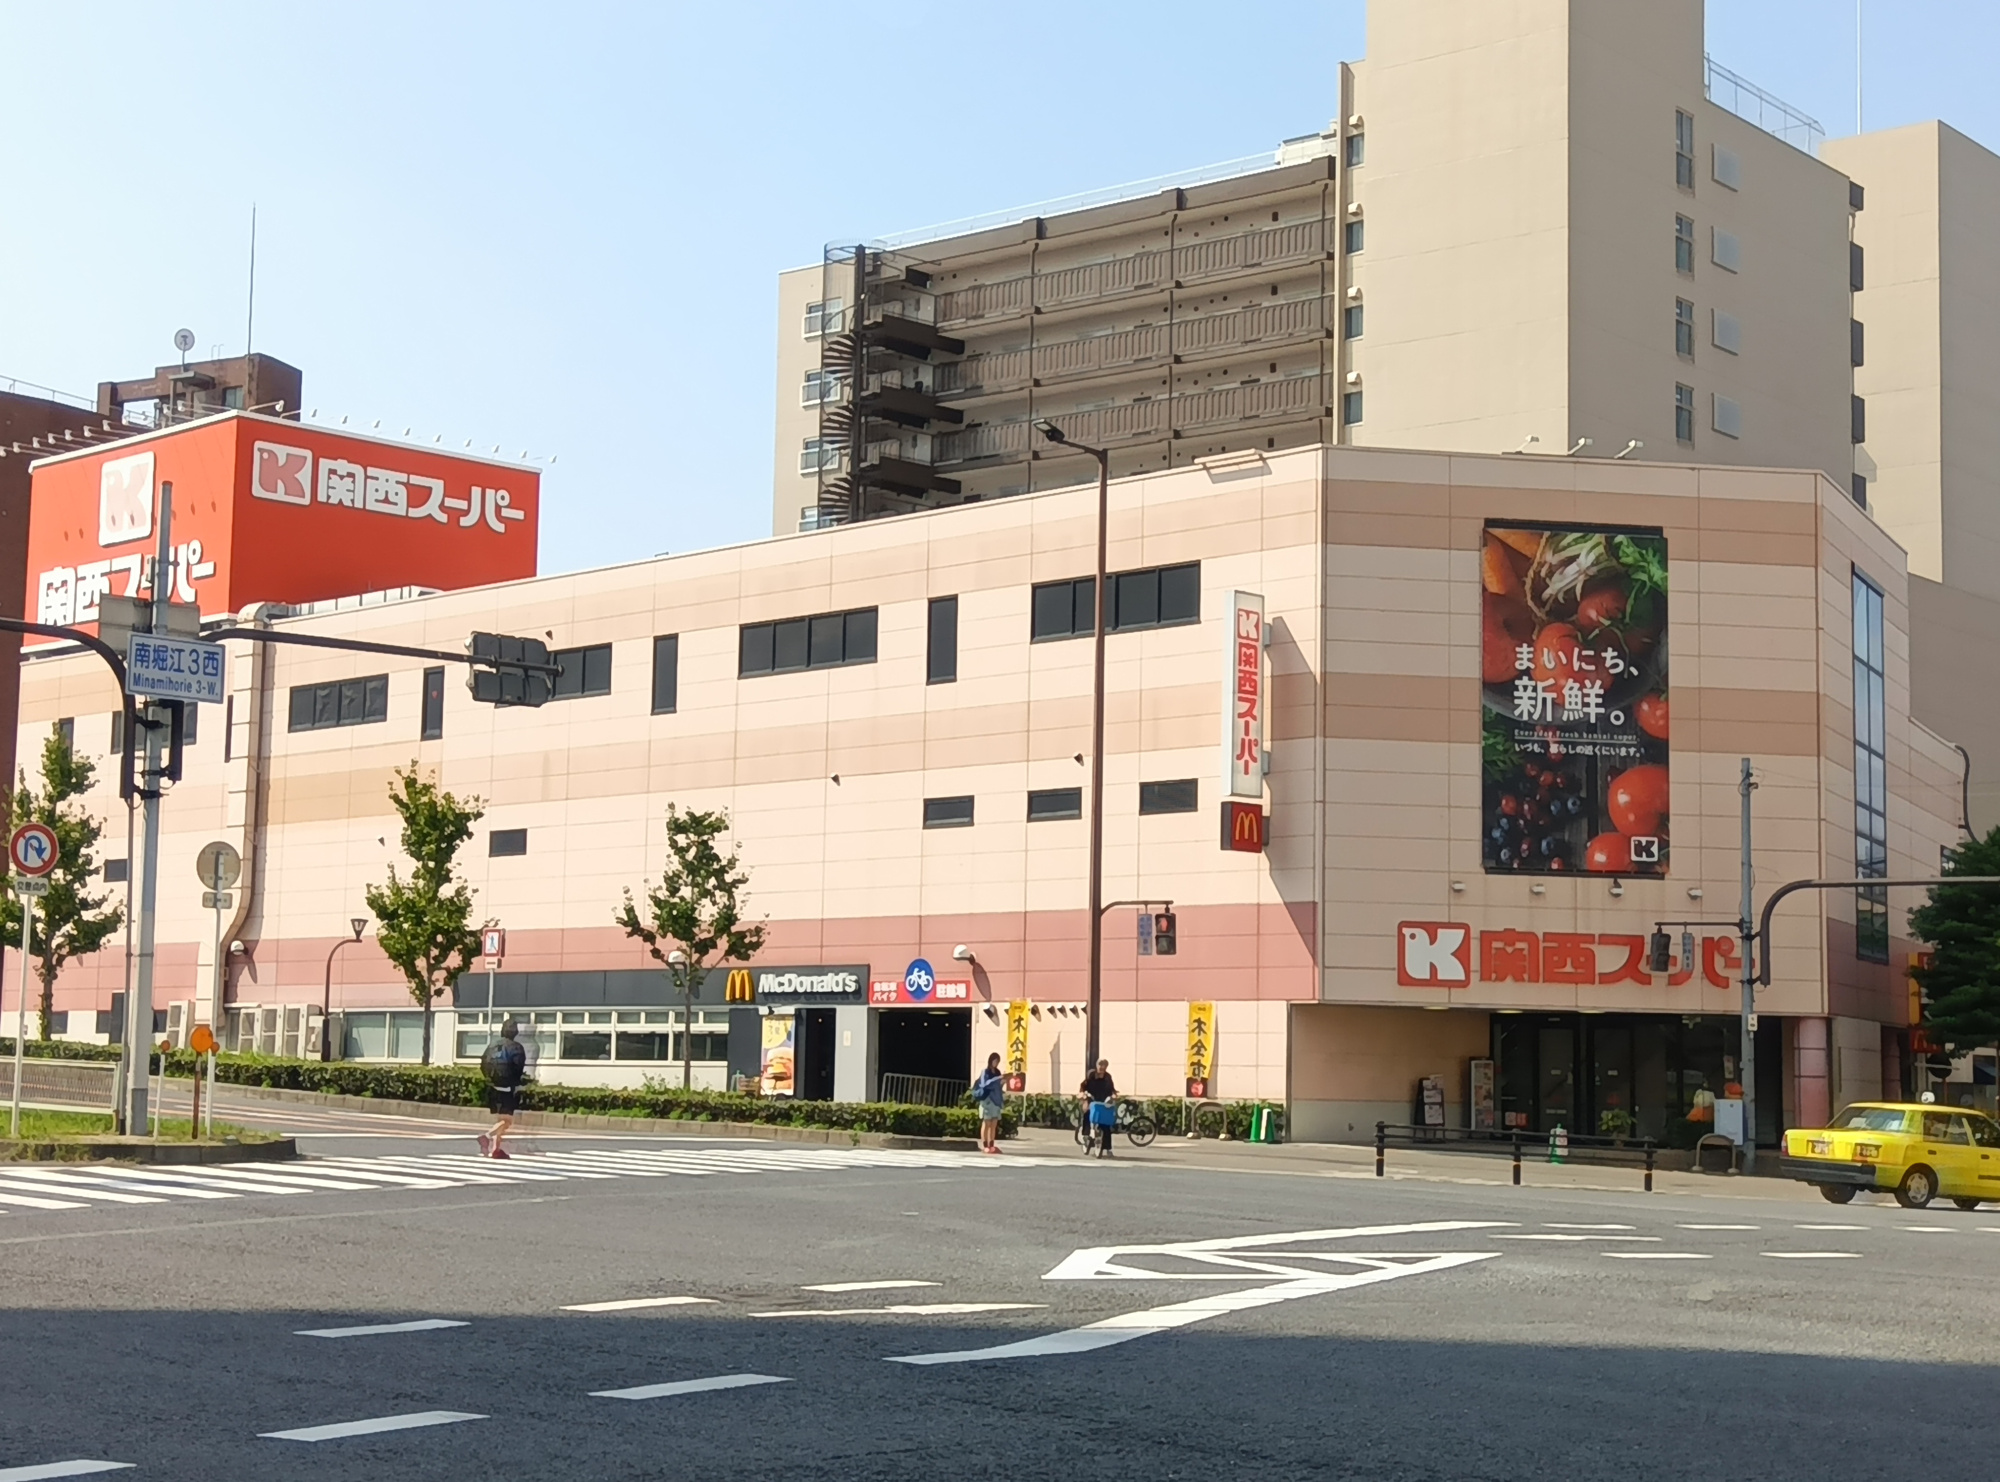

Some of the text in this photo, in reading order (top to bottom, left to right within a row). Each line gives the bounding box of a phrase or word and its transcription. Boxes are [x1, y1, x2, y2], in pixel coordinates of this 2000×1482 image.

[317, 457, 524, 533] 関西スーパー
[133, 643, 220, 677] 南堀江3西
[1514, 643, 1639, 676] まいにち、
[132, 672, 218, 696] Minamihorie 3-W.
[1513, 676, 1625, 726] 新鮮。
[1235, 642, 1258, 776] 関西スーパー
[758, 972, 859, 994] McDonald's
